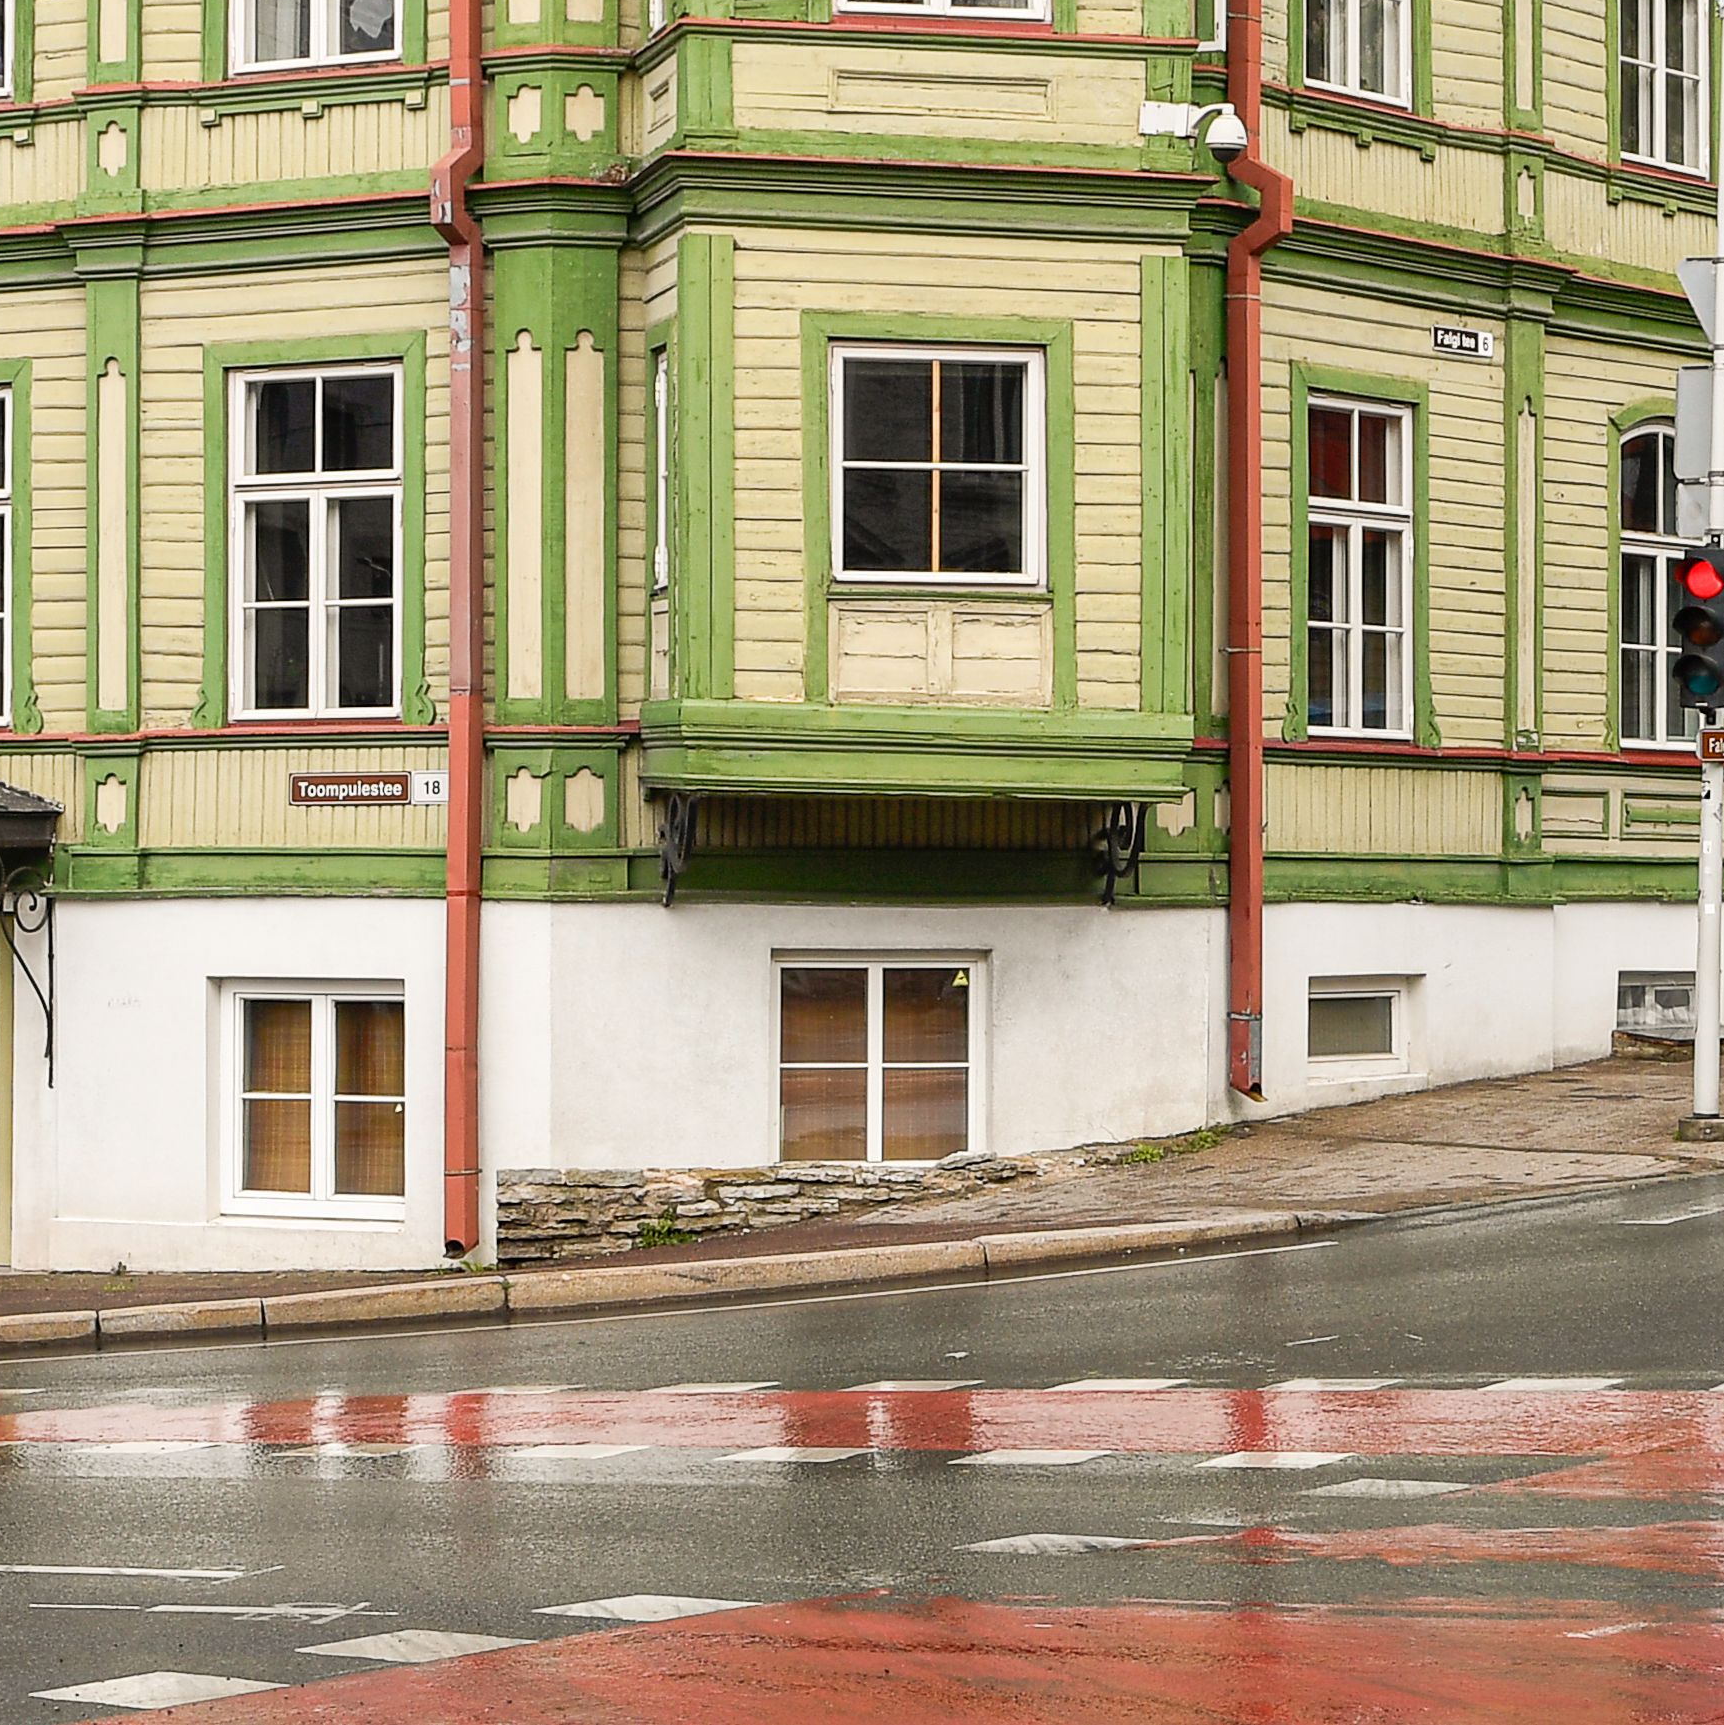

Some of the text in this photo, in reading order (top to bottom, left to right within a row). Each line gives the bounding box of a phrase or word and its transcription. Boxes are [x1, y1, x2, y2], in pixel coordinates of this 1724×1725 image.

[1437, 330, 1489, 352] Falgi tee 6
[298, 780, 403, 801] Toompuiestee
[423, 780, 441, 795] 18
